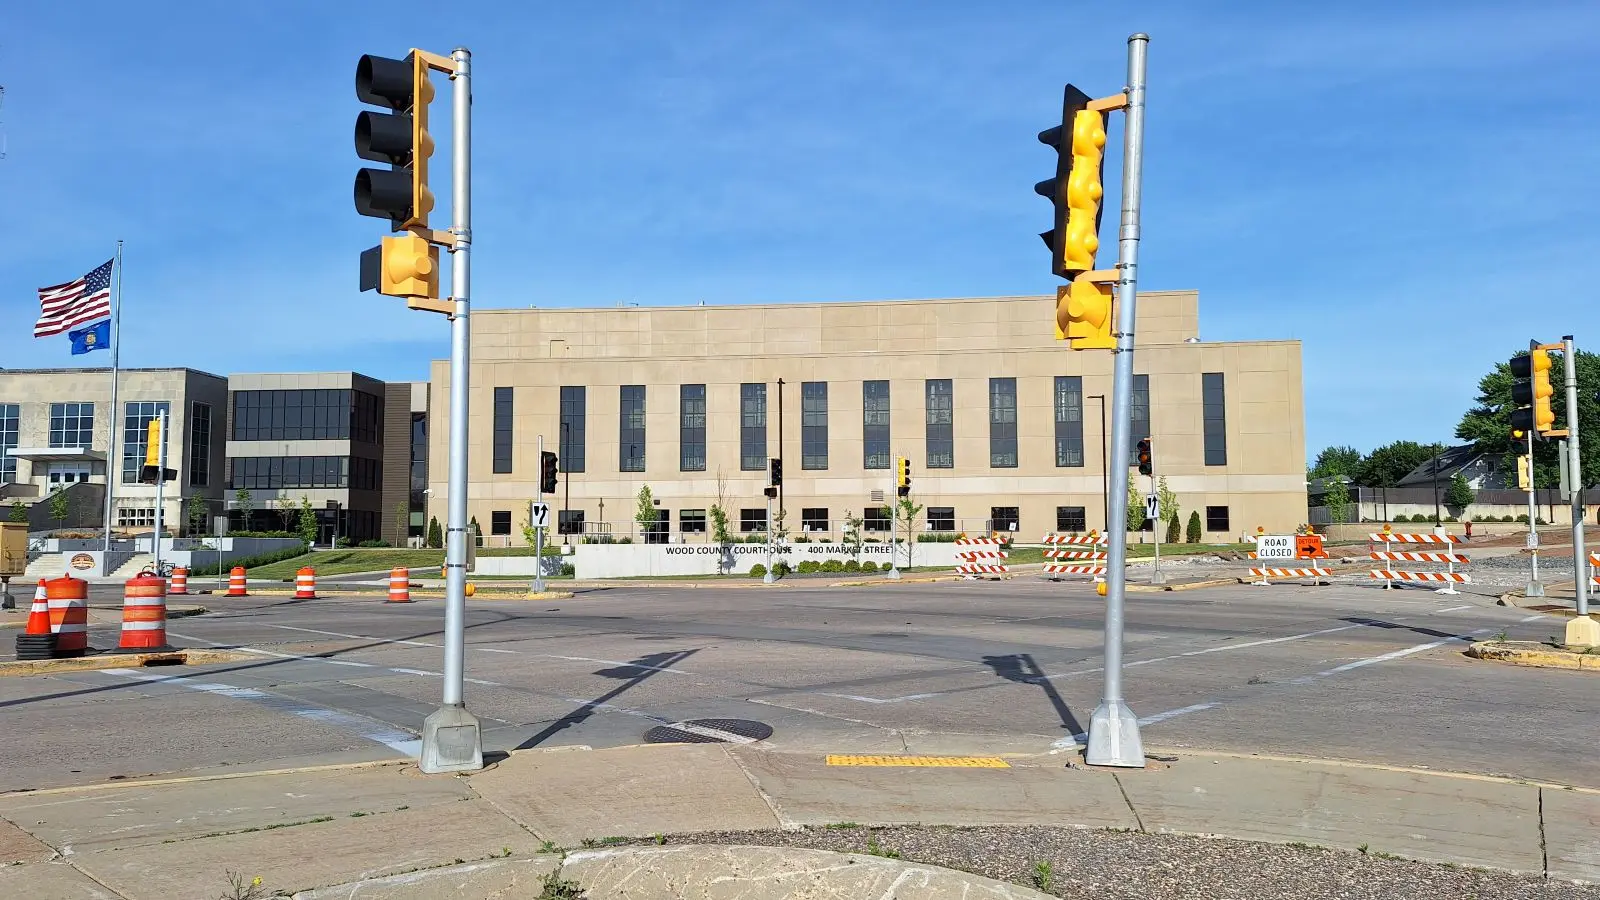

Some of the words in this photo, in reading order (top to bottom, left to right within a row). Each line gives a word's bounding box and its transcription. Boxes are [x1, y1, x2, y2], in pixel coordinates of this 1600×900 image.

[1264, 539, 1288, 547] ROAD
[666, 546, 694, 555] WOOD
[696, 546, 731, 555] COUNTY
[734, 546, 792, 554] COURTHOUSE
[807, 546, 824, 554] 400
[826, 546, 862, 554] MARKET
